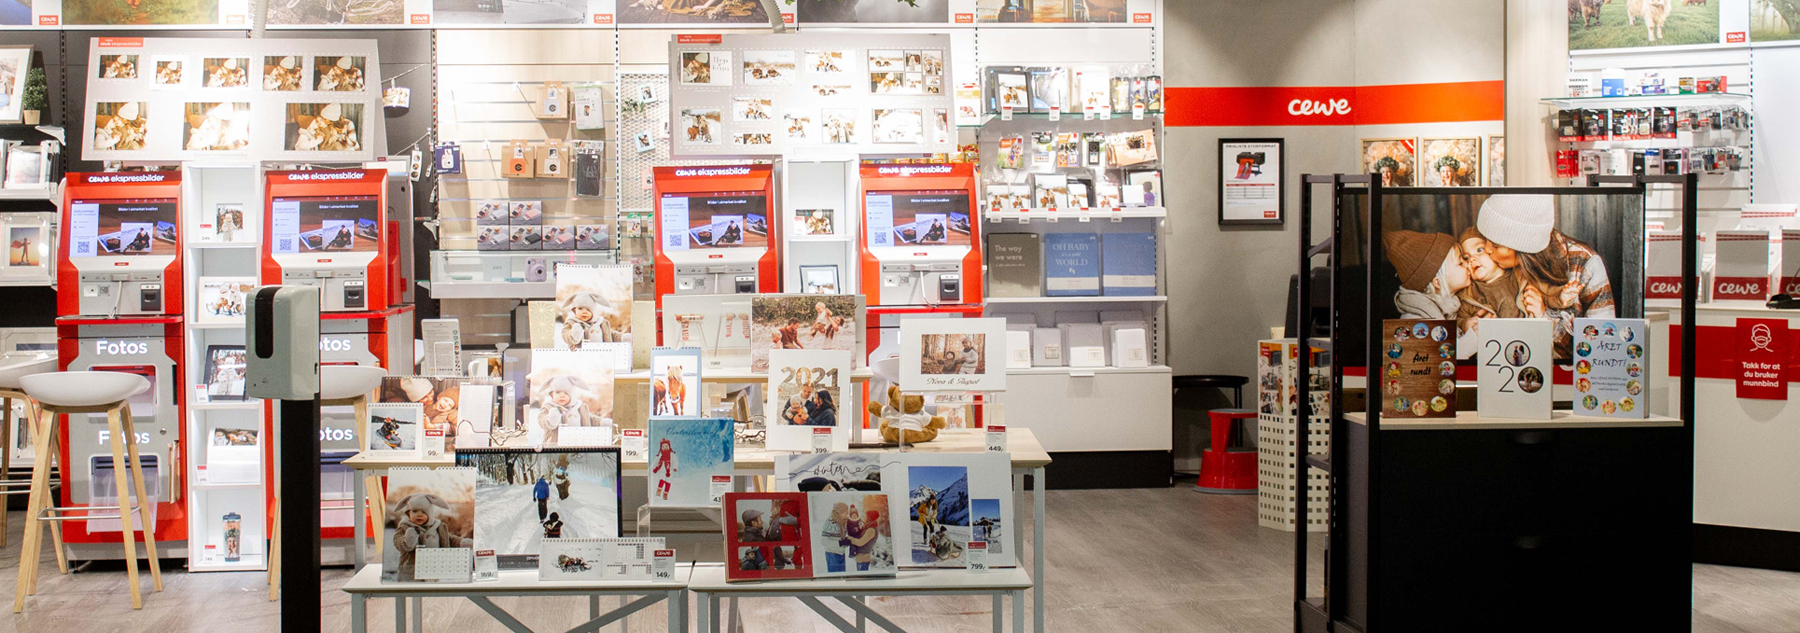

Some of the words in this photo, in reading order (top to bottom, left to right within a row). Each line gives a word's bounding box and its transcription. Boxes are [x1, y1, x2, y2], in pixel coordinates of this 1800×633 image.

[1288, 96, 1351, 117] cewe
[311, 171, 364, 181] ekspressbilder
[697, 167, 751, 177] ekspressbilder
[110, 174, 164, 183] ekspressbilder
[994, 244, 1006, 252] The
[1007, 246, 1023, 254] way
[1052, 243, 1067, 251] OH
[1067, 243, 1090, 251] BABY
[1055, 258, 1089, 266] WORLD
[1650, 282, 1682, 294] cew
[1718, 282, 1760, 295] cewe
[1786, 282, 1800, 294] ce
[96, 340, 148, 355] Fotos
[1412, 350, 1429, 363] Året
[1591, 358, 1627, 368] RUNDT!
[1742, 361, 1760, 370] Takk
[1760, 362, 1772, 370] for
[1410, 366, 1432, 376] rundt
[1754, 371, 1779, 379] bruker
[781, 366, 839, 389] 2021
[1742, 380, 1779, 388] munnbind
[98, 430, 150, 445] Fts
